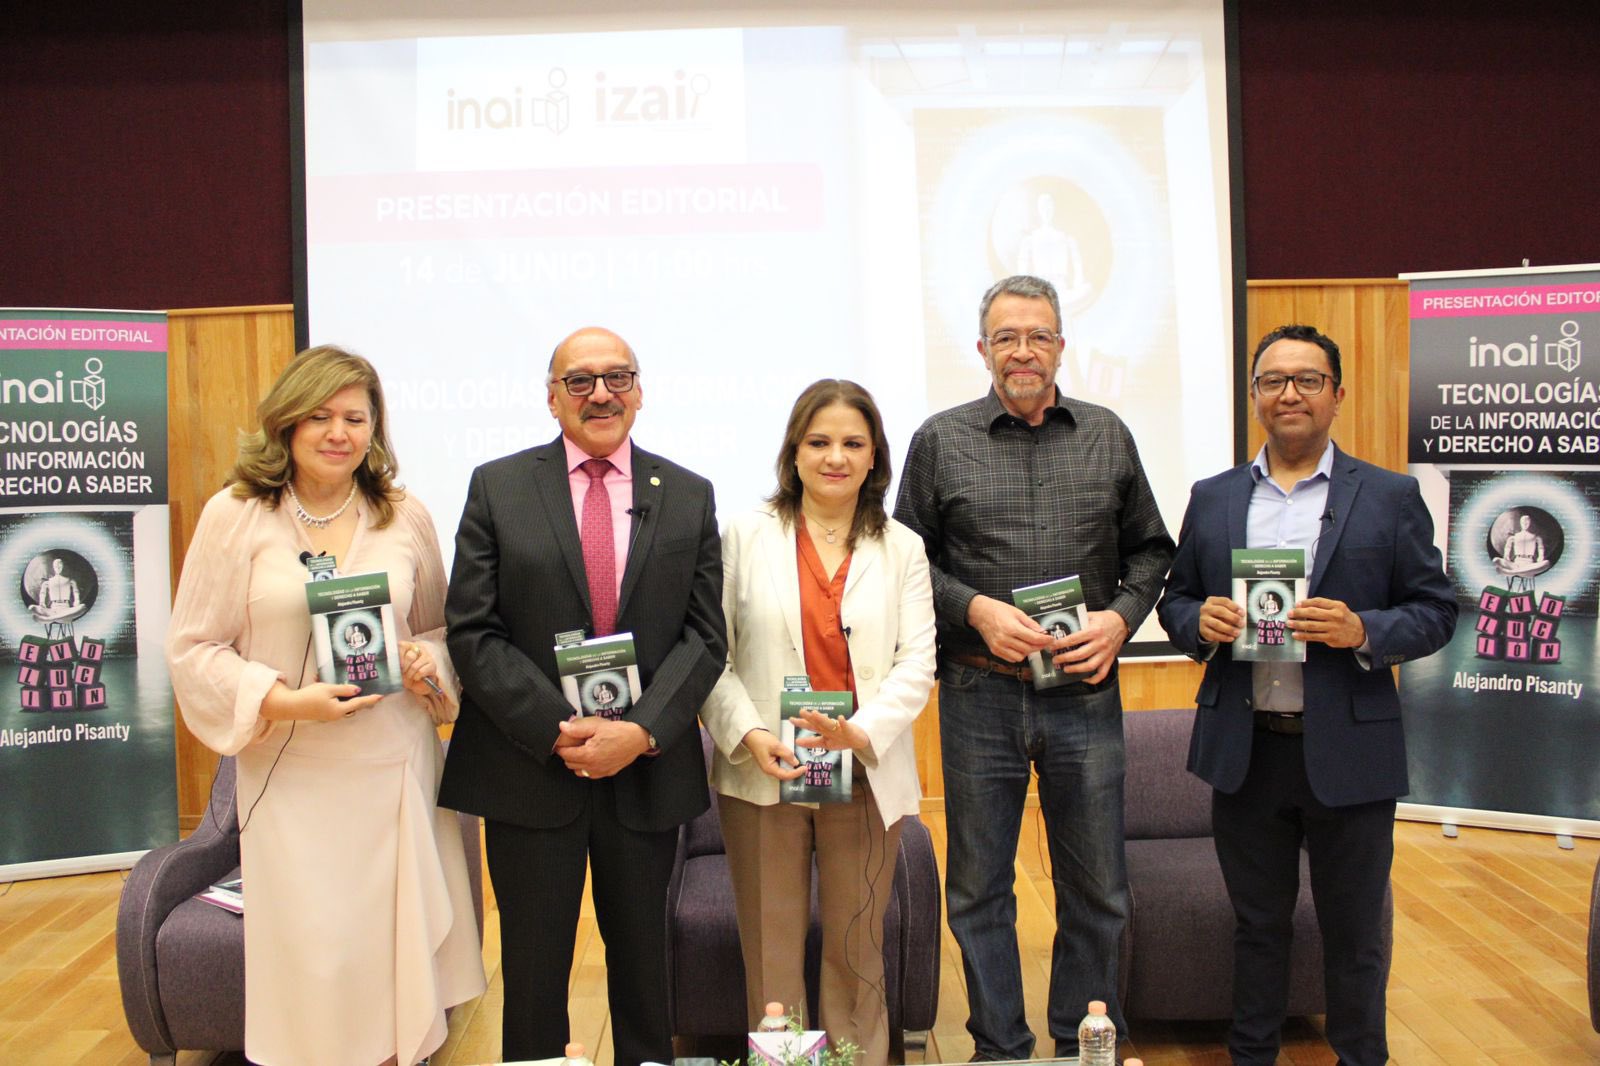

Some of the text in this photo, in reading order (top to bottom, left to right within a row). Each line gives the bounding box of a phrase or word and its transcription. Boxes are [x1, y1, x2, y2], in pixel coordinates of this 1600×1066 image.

[446, 86, 523, 131] inai
[595, 69, 686, 122] izai
[376, 184, 789, 222] PRESENTACIÓN EDITORIAL
[493, 248, 596, 284] JUNIO
[1423, 291, 1542, 310] PRESENTACIÓN
[71, 328, 153, 343] EDITORIAL
[1469, 334, 1539, 367] inai
[0, 370, 64, 404] nai
[1438, 377, 1600, 405] TECNOLOGÍA
[1430, 415, 1452, 430] DE
[1455, 415, 1475, 430] LA
[1422, 438, 1434, 453] Y
[1438, 435, 1534, 453] DERECHO
[1537, 435, 1553, 453] A
[6, 447, 145, 471] INFORMACIÓN
[67, 477, 82, 494] A
[86, 475, 153, 494] SABER
[1453, 671, 1583, 699] Alejandro Pisanty
[0, 722, 131, 748] Alejandro Pisanty
